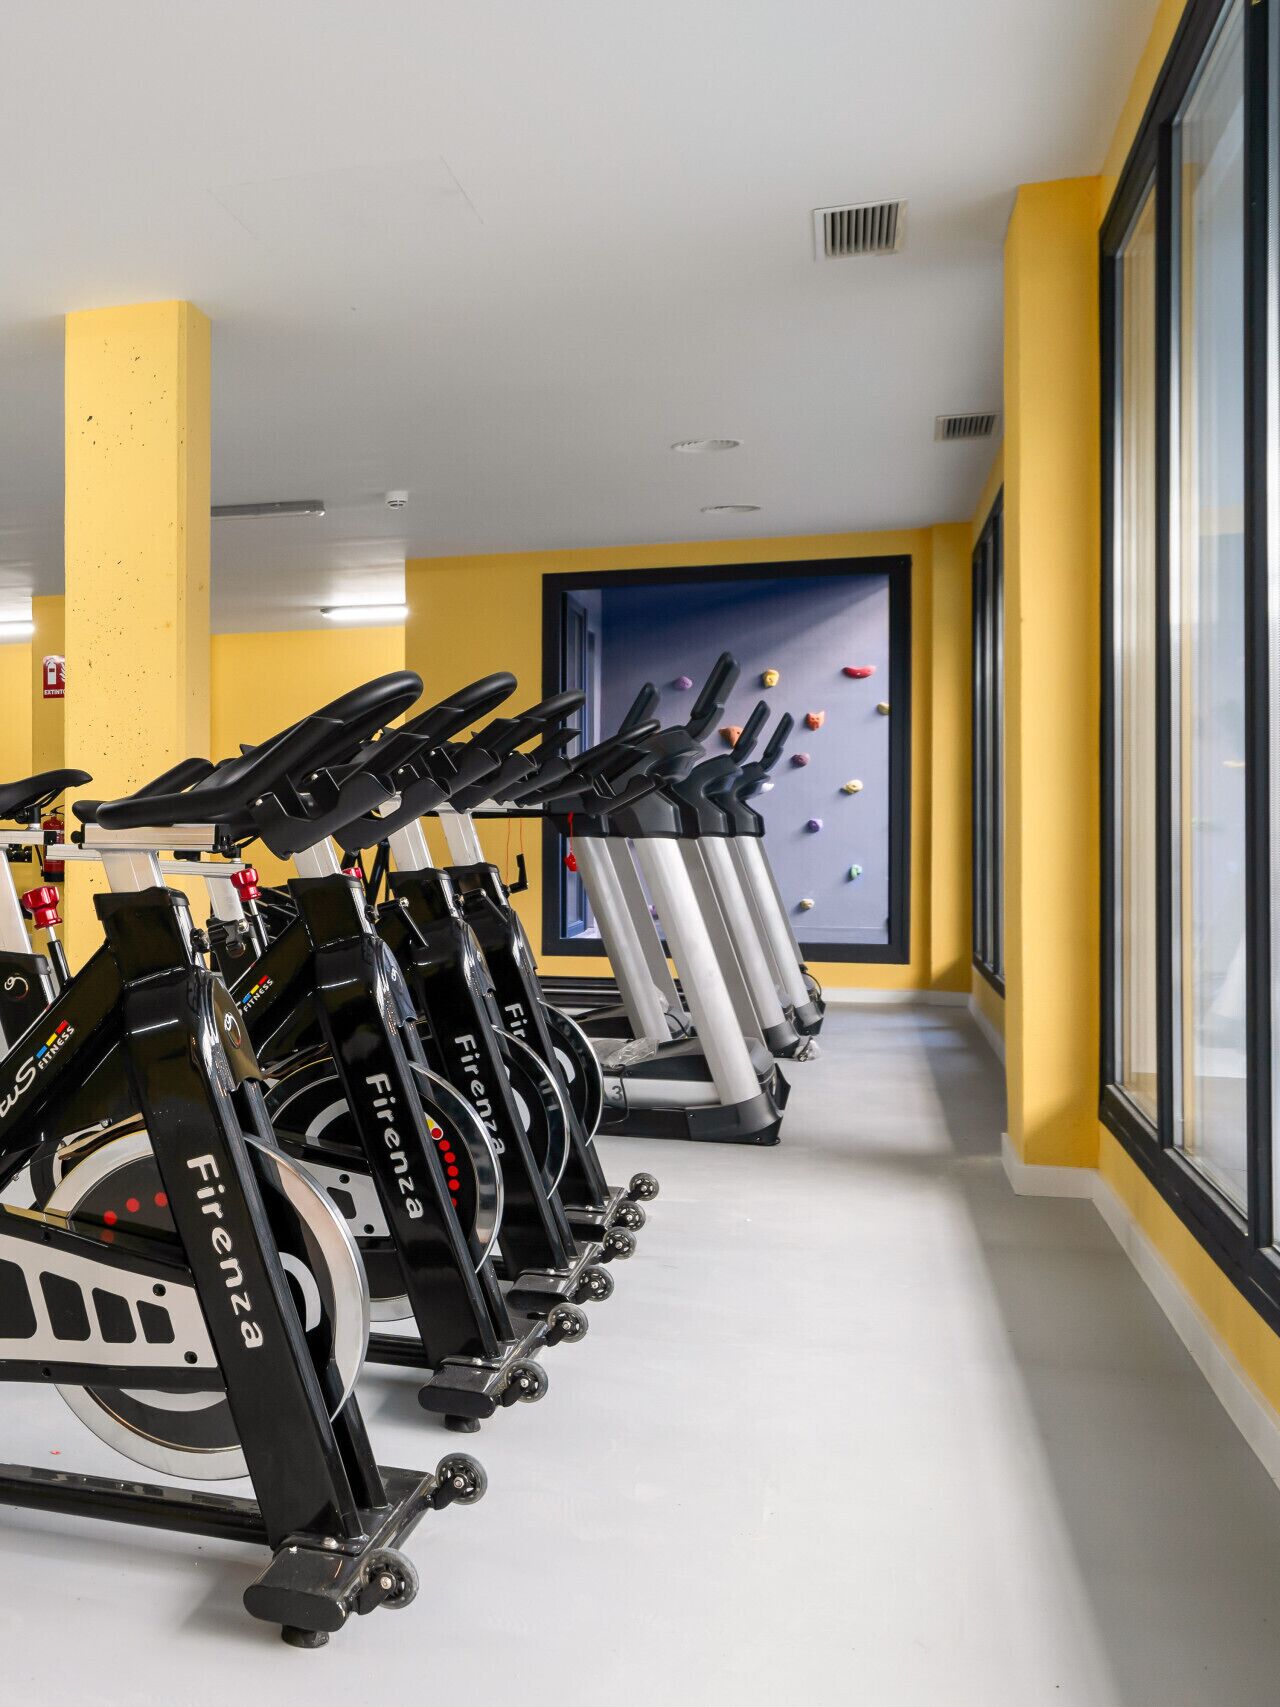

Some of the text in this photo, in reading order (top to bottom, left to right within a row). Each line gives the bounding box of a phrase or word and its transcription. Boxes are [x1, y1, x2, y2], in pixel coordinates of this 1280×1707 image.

[243, 978, 273, 1012] FITNESS
[37, 1025, 75, 1070] FITNESS
[454, 1034, 506, 1155] Firenza
[612, 1085, 623, 1101] 3
[365, 1073, 424, 1219] Firenza
[186, 1154, 263, 1349] Firenza
